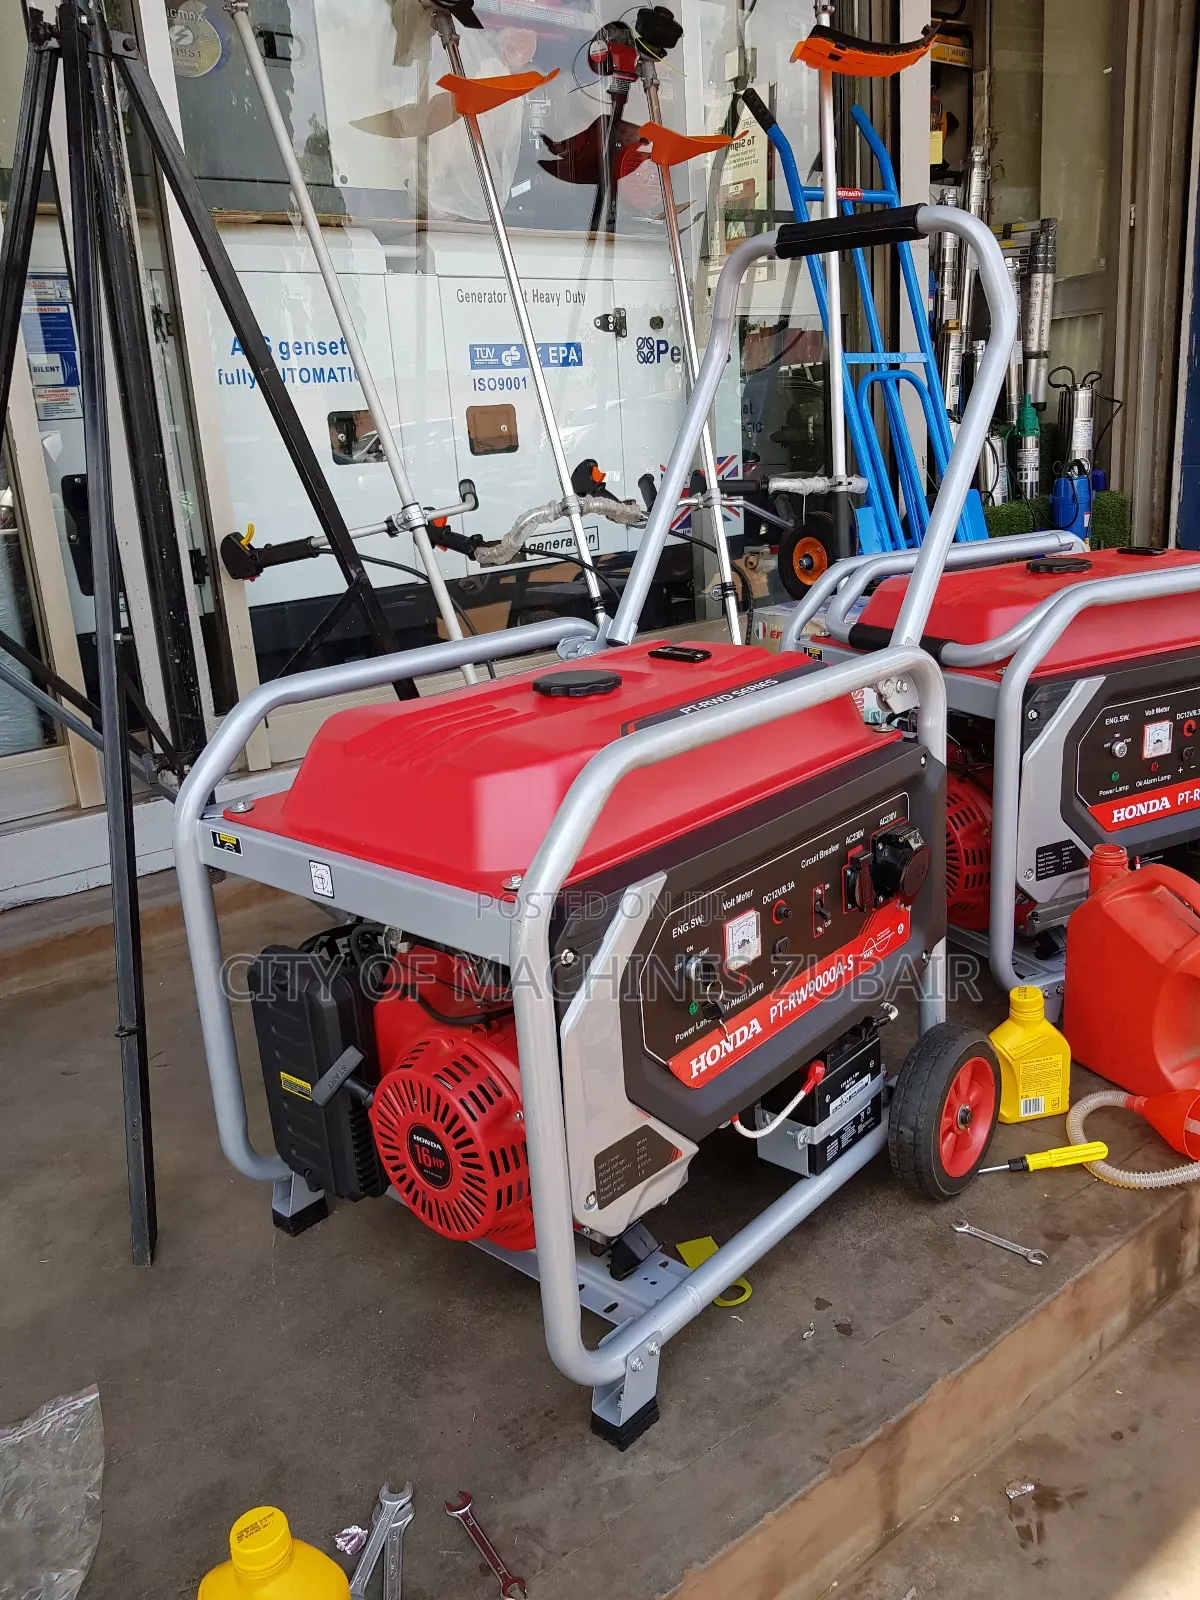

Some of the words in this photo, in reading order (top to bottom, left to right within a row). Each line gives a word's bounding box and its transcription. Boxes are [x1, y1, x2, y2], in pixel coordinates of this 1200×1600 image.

[456, 288, 507, 304] Generator
[532, 289, 561, 307] Heavy
[565, 289, 586, 306] Duty
[278, 337, 348, 361] genset
[474, 347, 495, 359] TÜV
[548, 346, 579, 364] EPA
[32, 365, 60, 373] SILENT
[217, 368, 256, 389] fully
[473, 376, 528, 392] ISO9001
[732, 679, 779, 697] SERIES
[1145, 707, 1156, 717] Volt
[1155, 706, 1171, 715] Meter
[1157, 773, 1172, 783] Lamp
[1098, 787, 1116, 797] Power
[1115, 784, 1130, 792] Lamp
[1111, 796, 1172, 824] HONDA
[800, 853, 820, 869] Circuit
[819, 843, 840, 860] Breaker
[722, 897, 735, 911] Volt
[735, 888, 754, 903] Meter
[686, 944, 694, 953] ON
[730, 994, 747, 1009] Alarm
[747, 982, 764, 997] Lamp
[689, 1017, 763, 1080] HONDA
[769, 954, 854, 1024] PT-RW9000A-S
[675, 1023, 695, 1044] Power
[327, 1064, 348, 1090] START
[413, 1133, 443, 1151] HONDA
[414, 1144, 432, 1169] 16
[432, 1156, 445, 1169] HP
